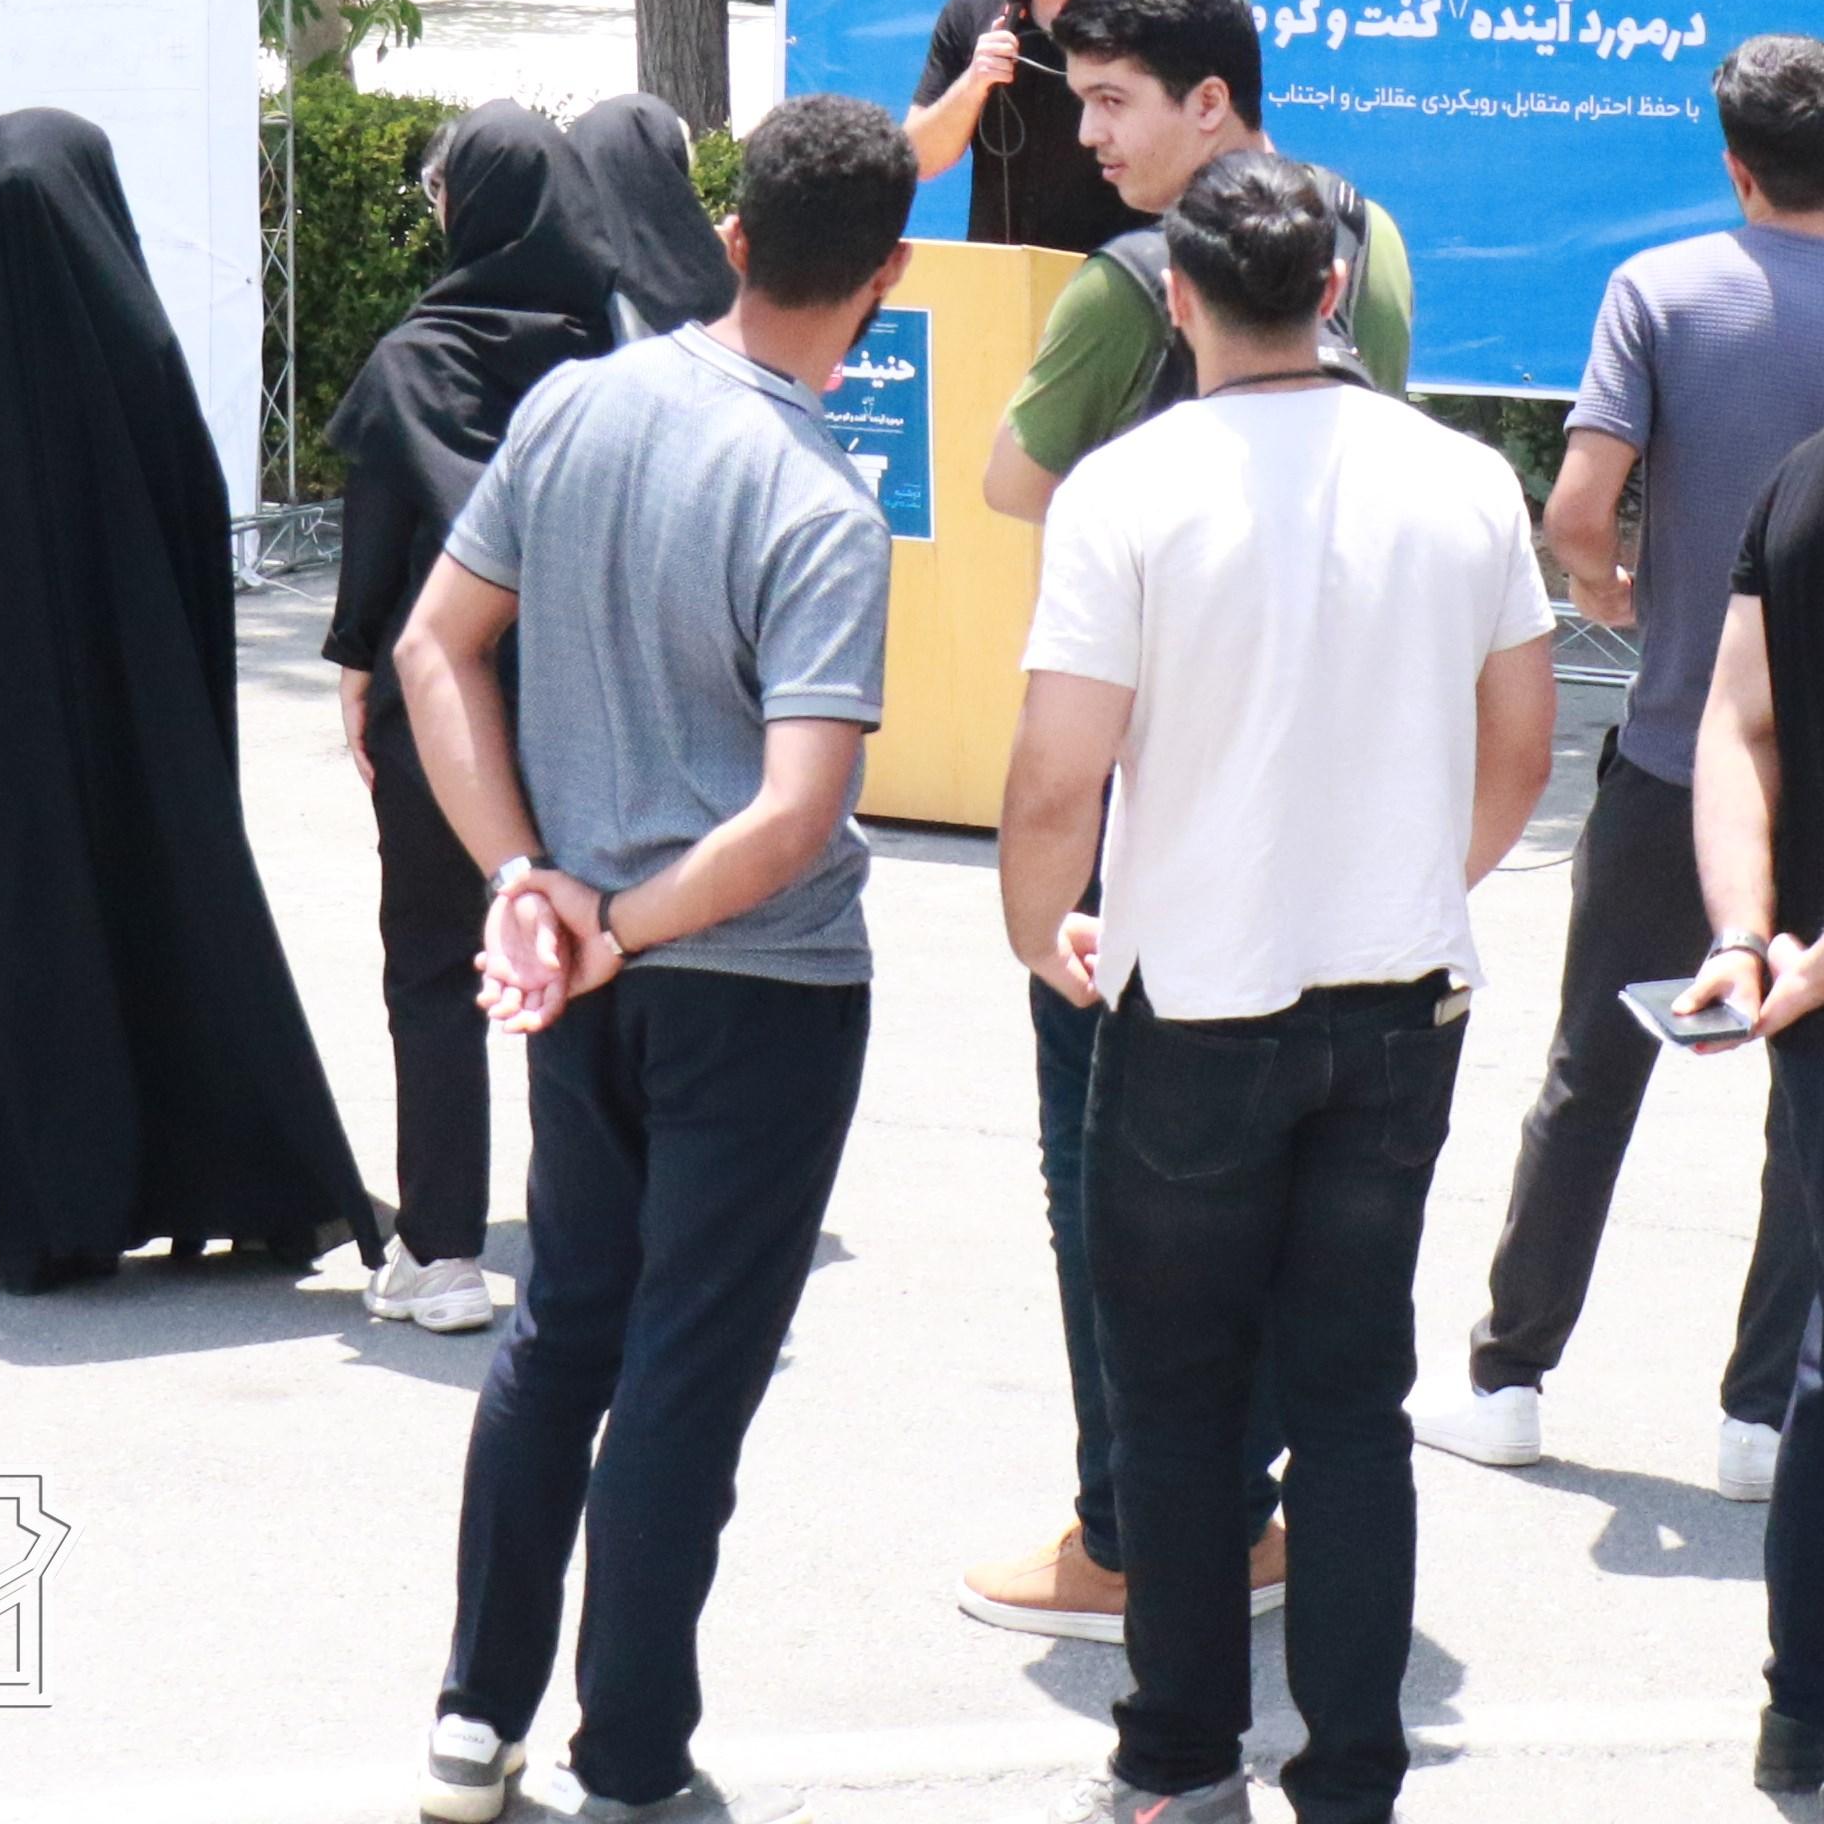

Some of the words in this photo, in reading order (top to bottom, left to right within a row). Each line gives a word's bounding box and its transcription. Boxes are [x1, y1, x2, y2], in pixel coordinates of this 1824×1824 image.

[1268, 83, 1335, 110] اجتناب
[1340, 92, 1351, 111] و
[1354, 86, 1417, 113] عقلانی
[1422, 88, 1498, 118] رویکردی
[1574, 94, 1632, 121] احترام
[1637, 96, 1680, 117] حفظ
[1686, 97, 1700, 124] با
[842, 350, 915, 388] حنیف
